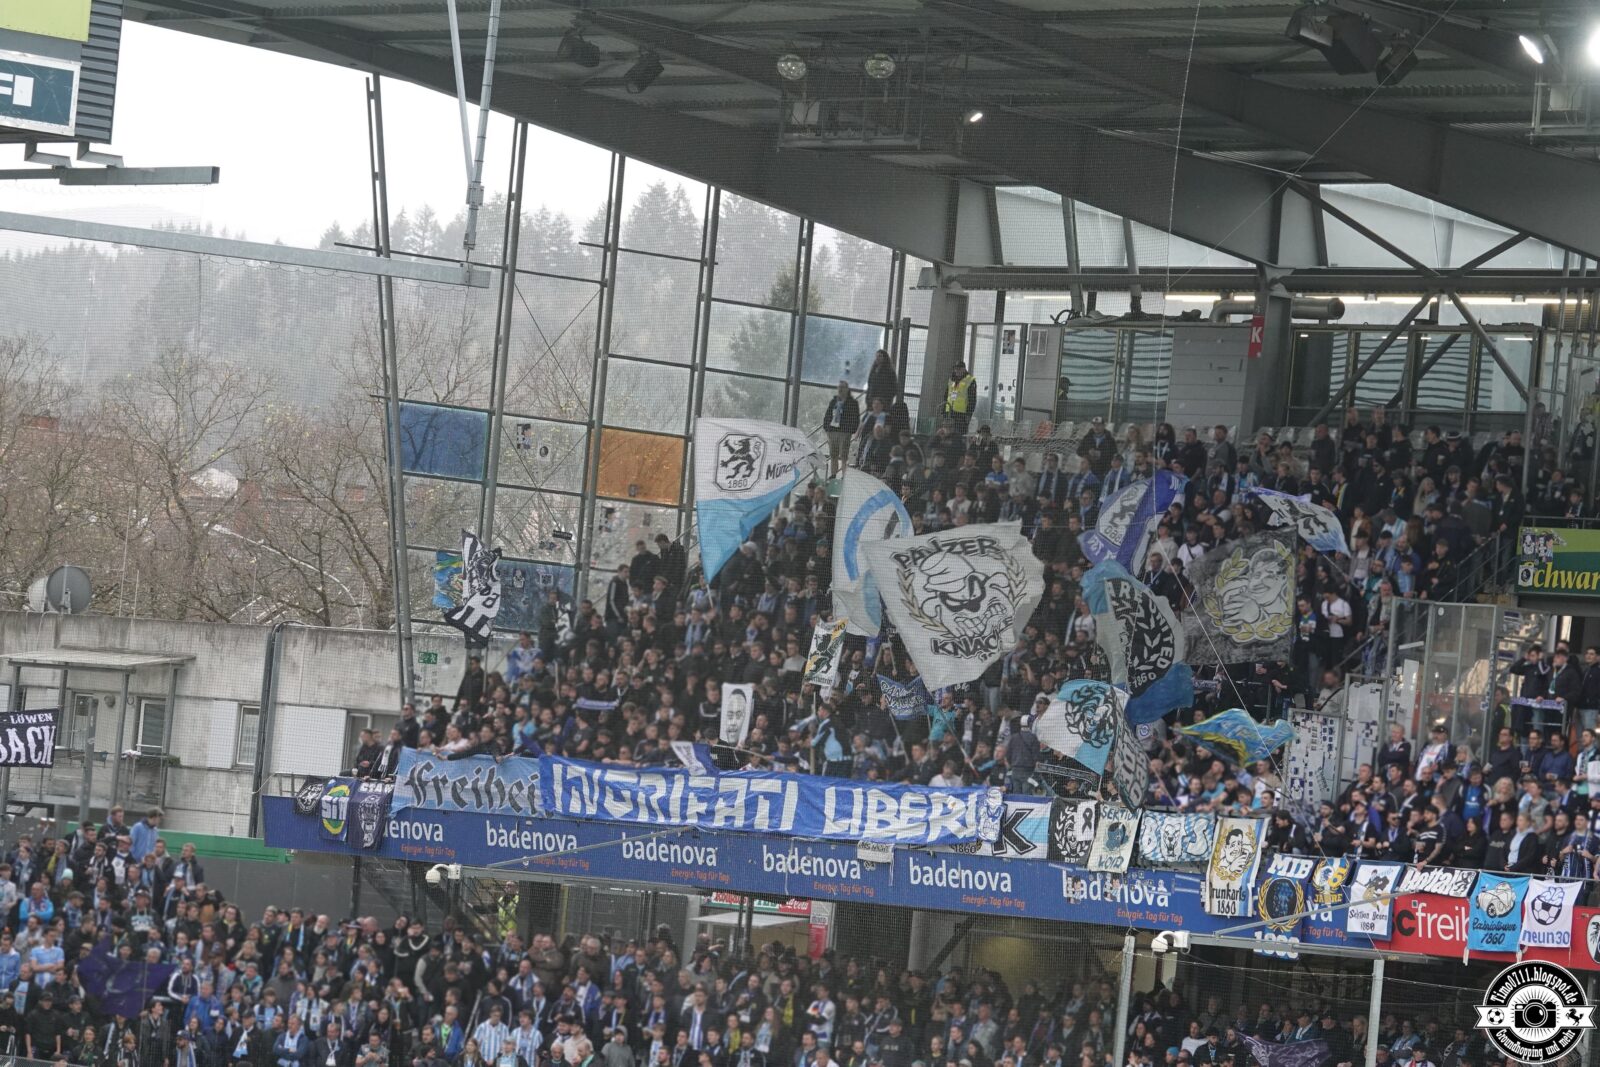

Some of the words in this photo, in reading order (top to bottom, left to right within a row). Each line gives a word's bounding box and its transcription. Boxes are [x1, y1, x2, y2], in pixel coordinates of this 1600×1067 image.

[1251, 326, 1261, 343] K
[727, 479, 748, 489] 1860
[889, 535, 1005, 570] PANZER
[1133, 671, 1157, 688] 1860
[404, 760, 548, 817] Freihei
[823, 785, 977, 842] LIBERI
[486, 820, 578, 852] badenova
[622, 832, 717, 867] badenova
[954, 843, 977, 854] 1860
[762, 845, 861, 880] badenova
[1267, 854, 1314, 879] MIB
[909, 857, 1012, 893] badenova
[1217, 900, 1236, 915] 1860
[1145, 910, 1158, 923] Tag
[1158, 911, 1170, 922] für
[1170, 912, 1183, 926] Tag
[1309, 926, 1321, 939] Tag
[1322, 927, 1333, 938] für
[1481, 932, 1506, 945] 1860
[1522, 929, 1571, 945] neun30
